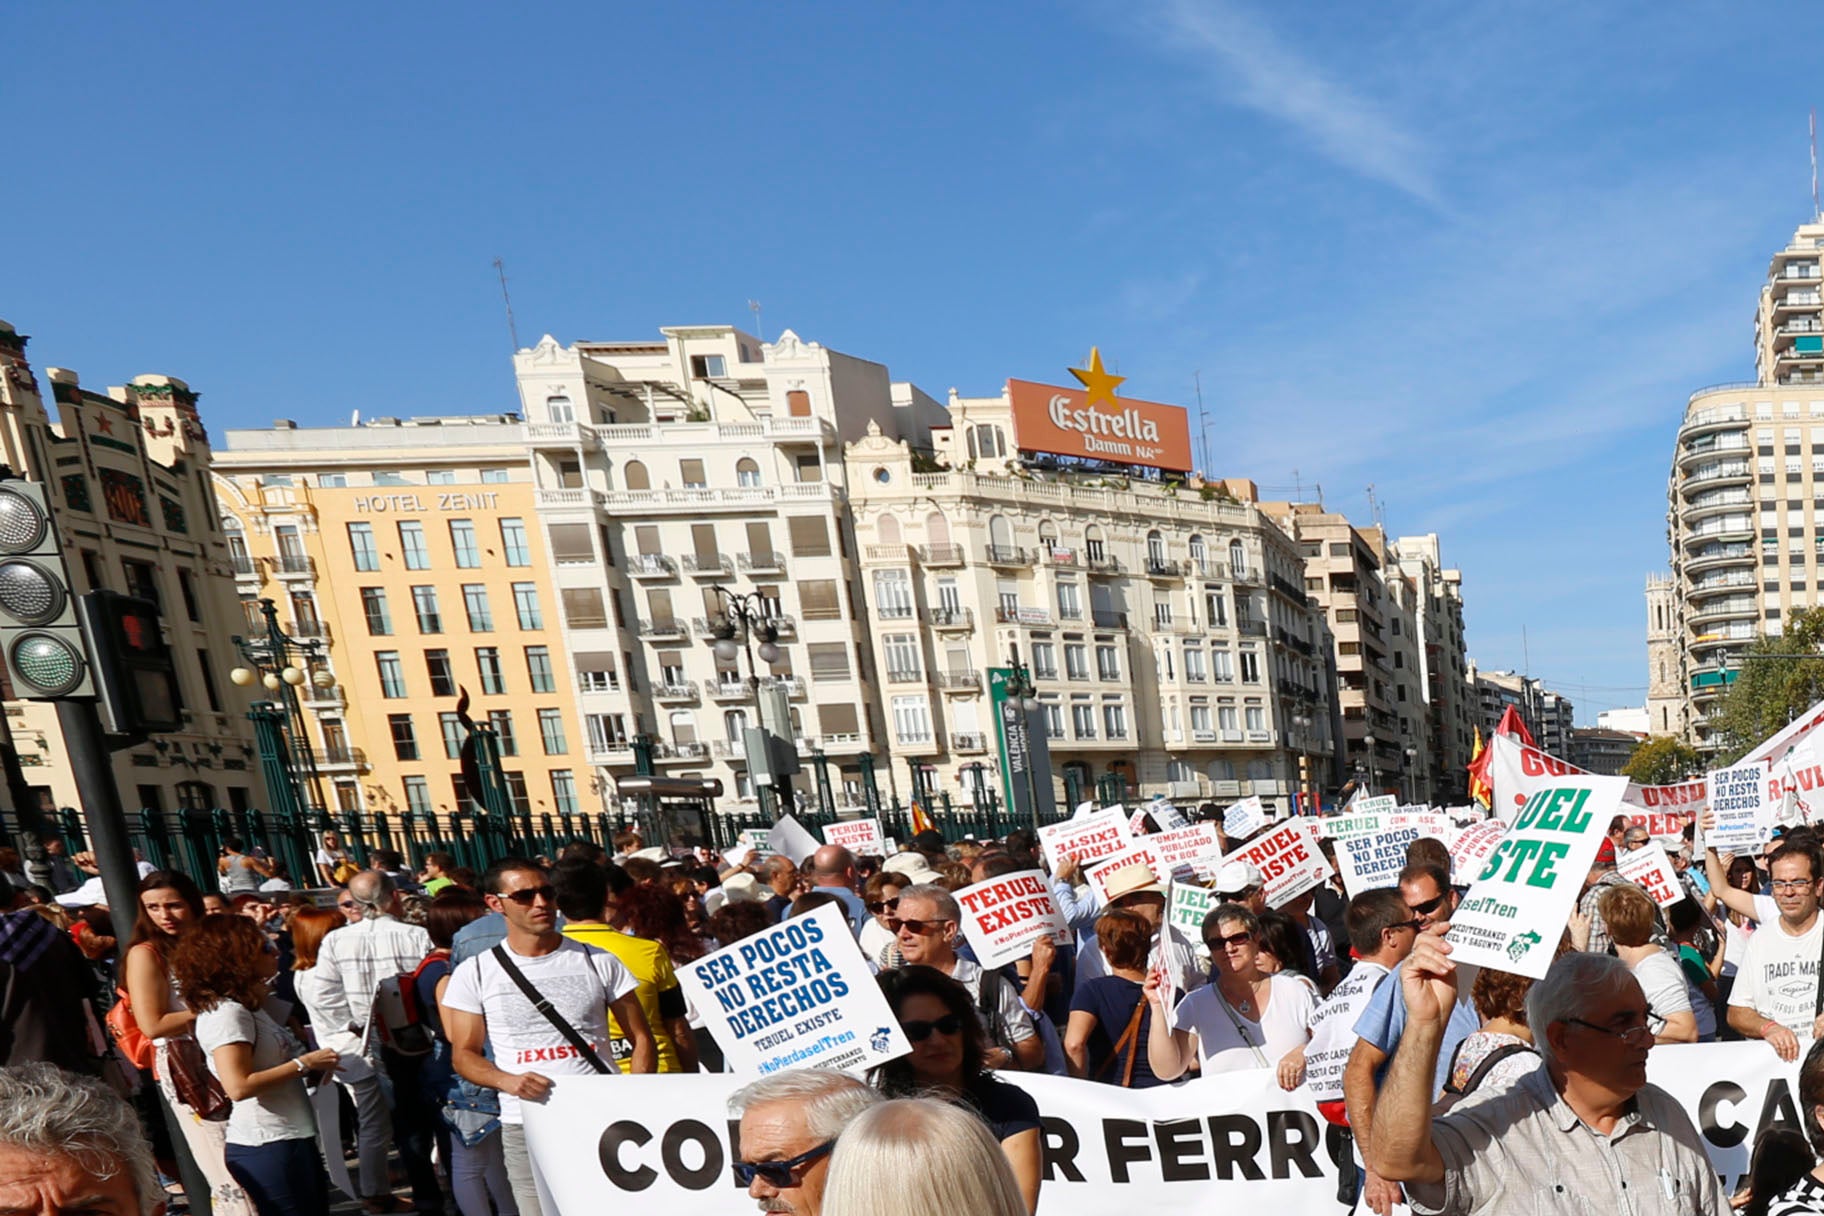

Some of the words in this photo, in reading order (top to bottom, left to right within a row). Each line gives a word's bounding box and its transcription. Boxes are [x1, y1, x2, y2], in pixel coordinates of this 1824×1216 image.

[1048, 394, 1160, 443] Estrella
[1083, 433, 1132, 455] Damm
[354, 495, 428, 512] HOTEL
[438, 491, 499, 511] ZENIT
[1714, 771, 1729, 785] SER
[1731, 767, 1761, 782] POCOS
[1713, 795, 1760, 811] DERECHOS
[1715, 785, 1727, 798] NO
[1728, 782, 1759, 796] RESTA
[1516, 788, 1593, 834] UEL
[828, 822, 873, 837] TERUEL
[833, 832, 875, 846] EXISTE
[1054, 827, 1119, 855] EXISTE
[1345, 836, 1372, 853] SER
[1375, 827, 1420, 844] POCOS
[1179, 849, 1199, 861] BOE
[1352, 850, 1371, 864] NO
[1374, 842, 1409, 859] REST
[1478, 838, 1571, 890] STE
[1353, 856, 1408, 877] DERECH
[960, 875, 1048, 914] TERUEL
[976, 896, 1056, 936] EXISTE
[695, 954, 741, 990] SER
[738, 917, 825, 970] POCOS
[714, 982, 747, 1014] NO
[745, 948, 833, 1000] RESTA
[1763, 961, 1797, 983] TRADE
[726, 972, 850, 1040] DERECHOS
[753, 1028, 795, 1053] TERUEL
[796, 1008, 844, 1037] EXISTE
[757, 1030, 857, 1075] #NoPierdaselTren
